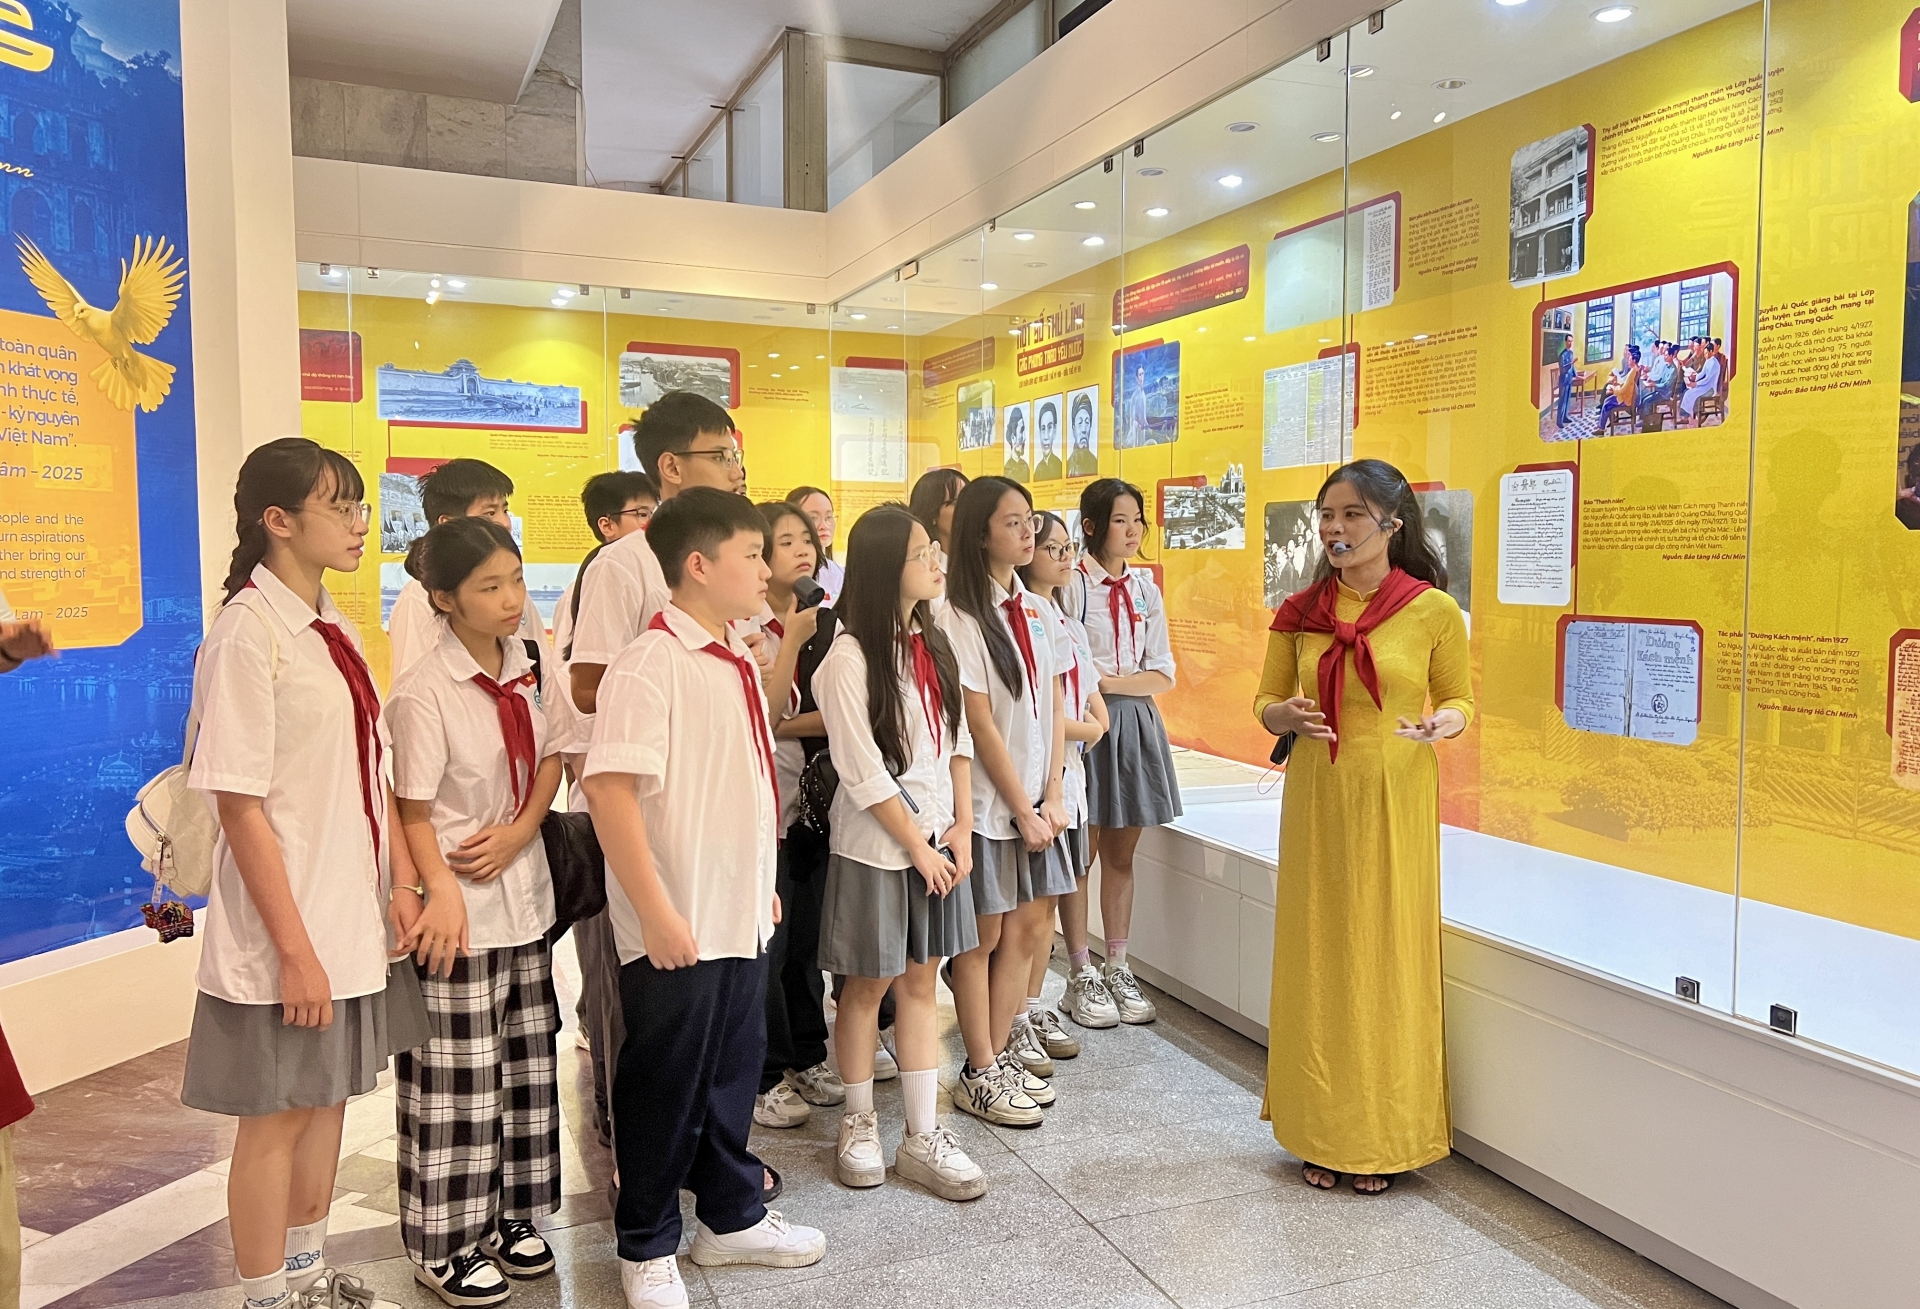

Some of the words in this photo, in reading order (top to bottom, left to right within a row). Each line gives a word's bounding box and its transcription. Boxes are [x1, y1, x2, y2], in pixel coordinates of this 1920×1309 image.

[1768, 68, 1785, 77] uyện
[1759, 305, 1778, 315] guyễn
[1851, 322, 1873, 330] 4/1927,
[0, 338, 35, 355] toàn
[38, 345, 77, 361] quân
[9, 360, 41, 378] khát
[43, 368, 78, 386] vọng
[0, 382, 17, 397] nh
[22, 385, 57, 404] thực
[62, 388, 79, 406] tế,
[9, 405, 26, 424] kỷ
[28, 410, 79, 427] nguyên
[0, 428, 27, 446] Việt
[0, 462, 26, 478] âm
[42, 465, 83, 480] 2025
[0, 512, 30, 526] ople
[35, 513, 59, 524] and
[64, 514, 84, 525] the
[0, 532, 17, 542] urn
[21, 531, 85, 545] aspirations
[0, 549, 24, 560] ther
[29, 549, 61, 563] bring
[65, 552, 86, 561] our
[0, 568, 16, 579] nd
[20, 568, 71, 581] strength
[74, 567, 86, 578] of
[56, 607, 88, 618] 2025
